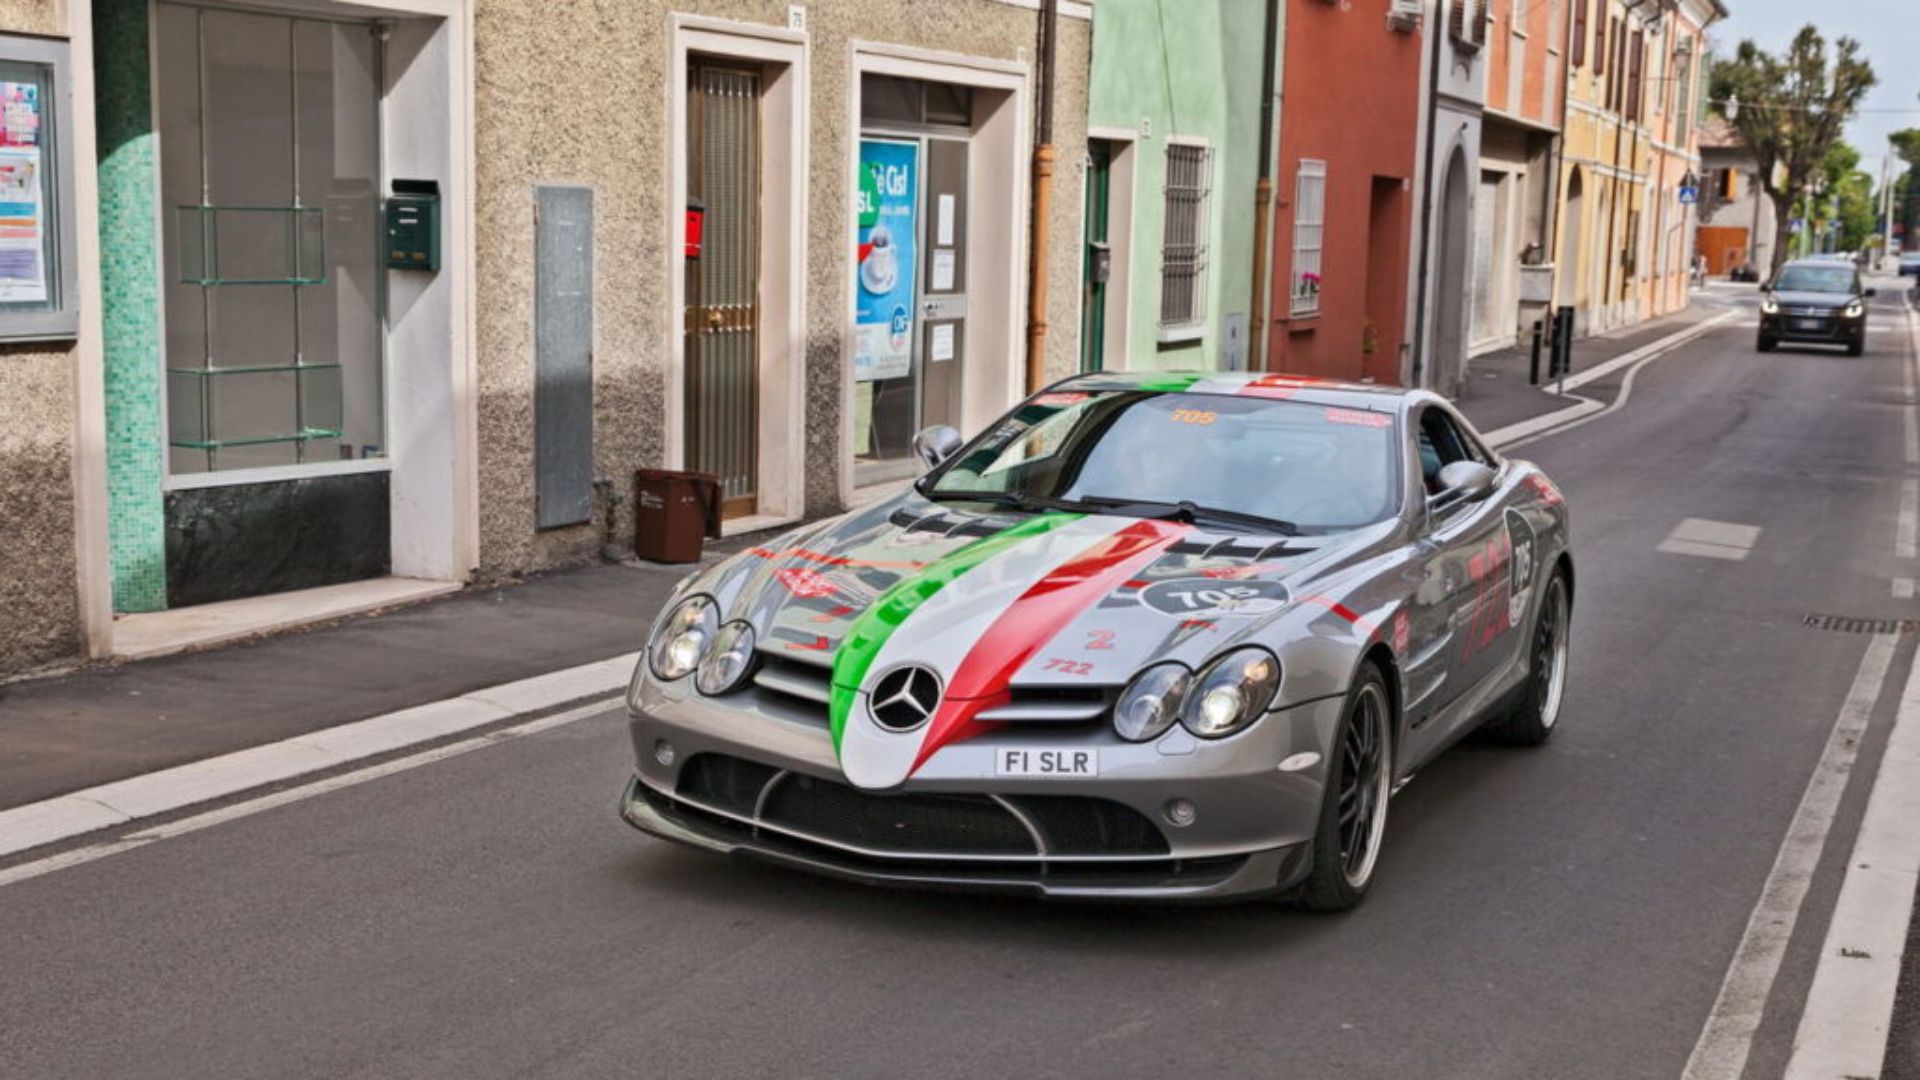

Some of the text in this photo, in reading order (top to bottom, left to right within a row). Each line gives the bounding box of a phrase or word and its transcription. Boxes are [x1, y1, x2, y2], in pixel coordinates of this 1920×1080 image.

[1170, 409, 1217, 425] 705
[1166, 586, 1260, 609] 705
[1085, 628, 1116, 651] 2
[1043, 658, 1094, 675] 722
[1040, 751, 1089, 773] SLR
